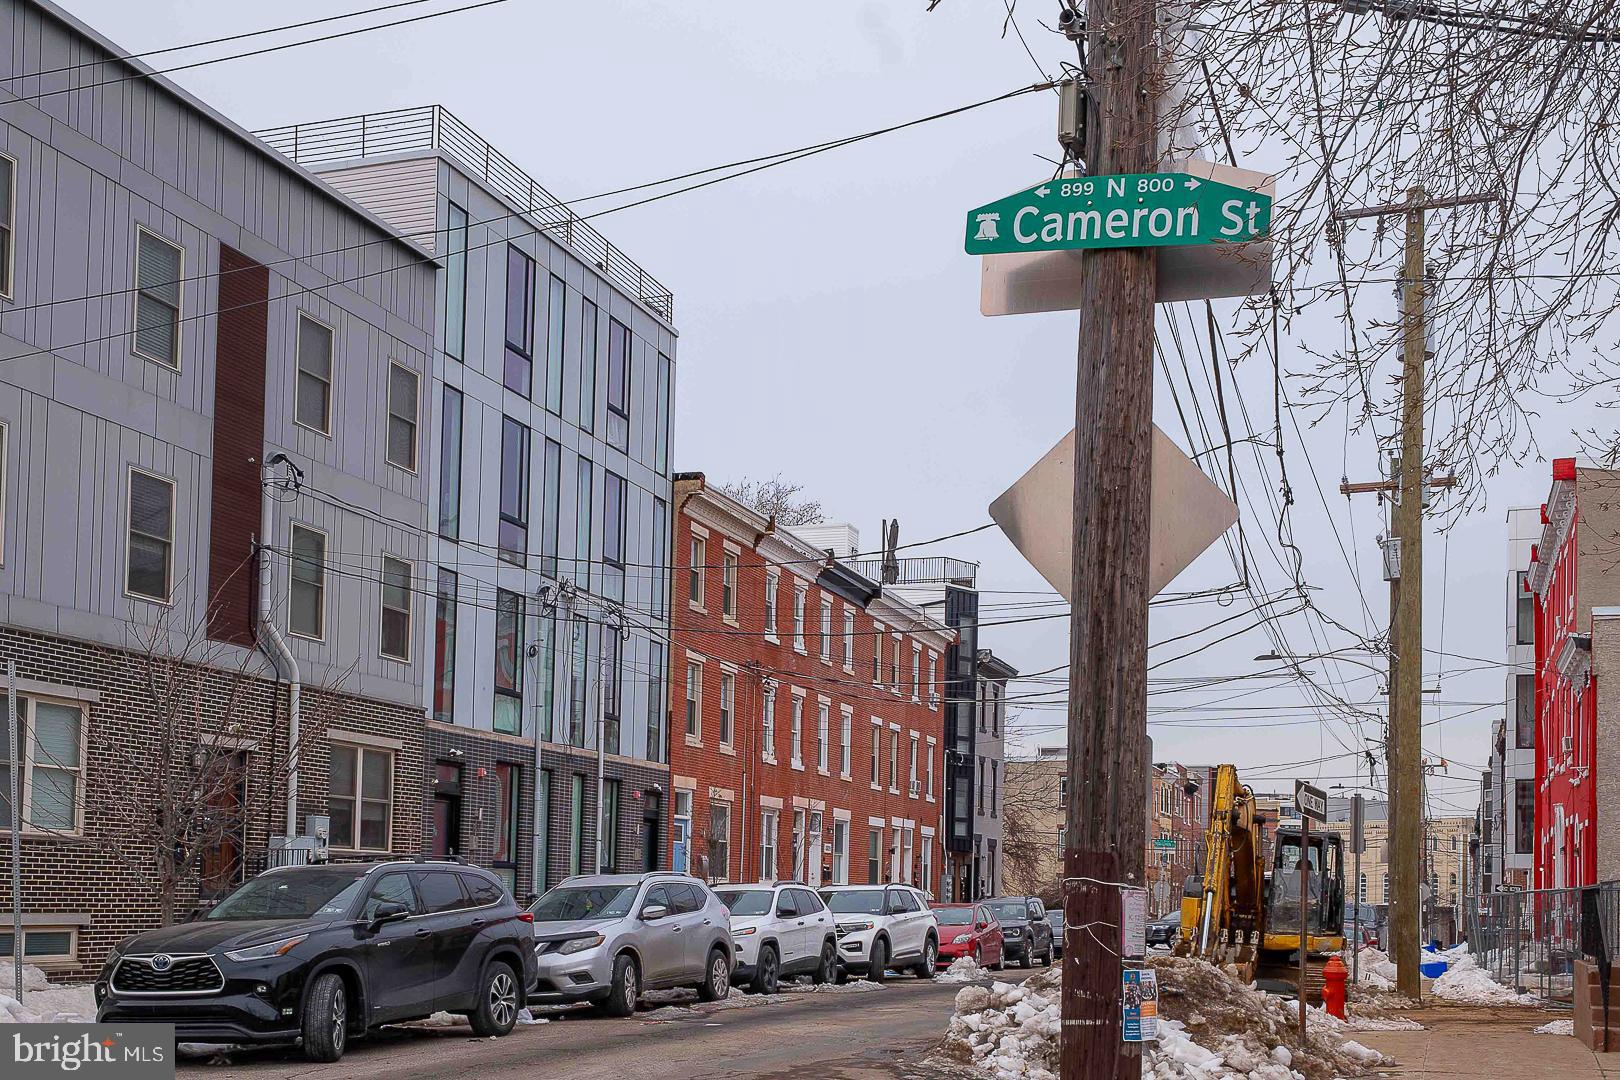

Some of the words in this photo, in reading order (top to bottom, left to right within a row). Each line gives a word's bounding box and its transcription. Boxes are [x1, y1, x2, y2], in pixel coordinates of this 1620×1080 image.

[1060, 182, 1094, 197] 899
[1107, 177, 1126, 198] N
[1137, 178, 1174, 193] 800
[1013, 203, 1199, 244] Cameron
[1219, 199, 1261, 236] St
[1304, 793, 1314, 808] ONE
[1314, 797, 1324, 813] WAY
